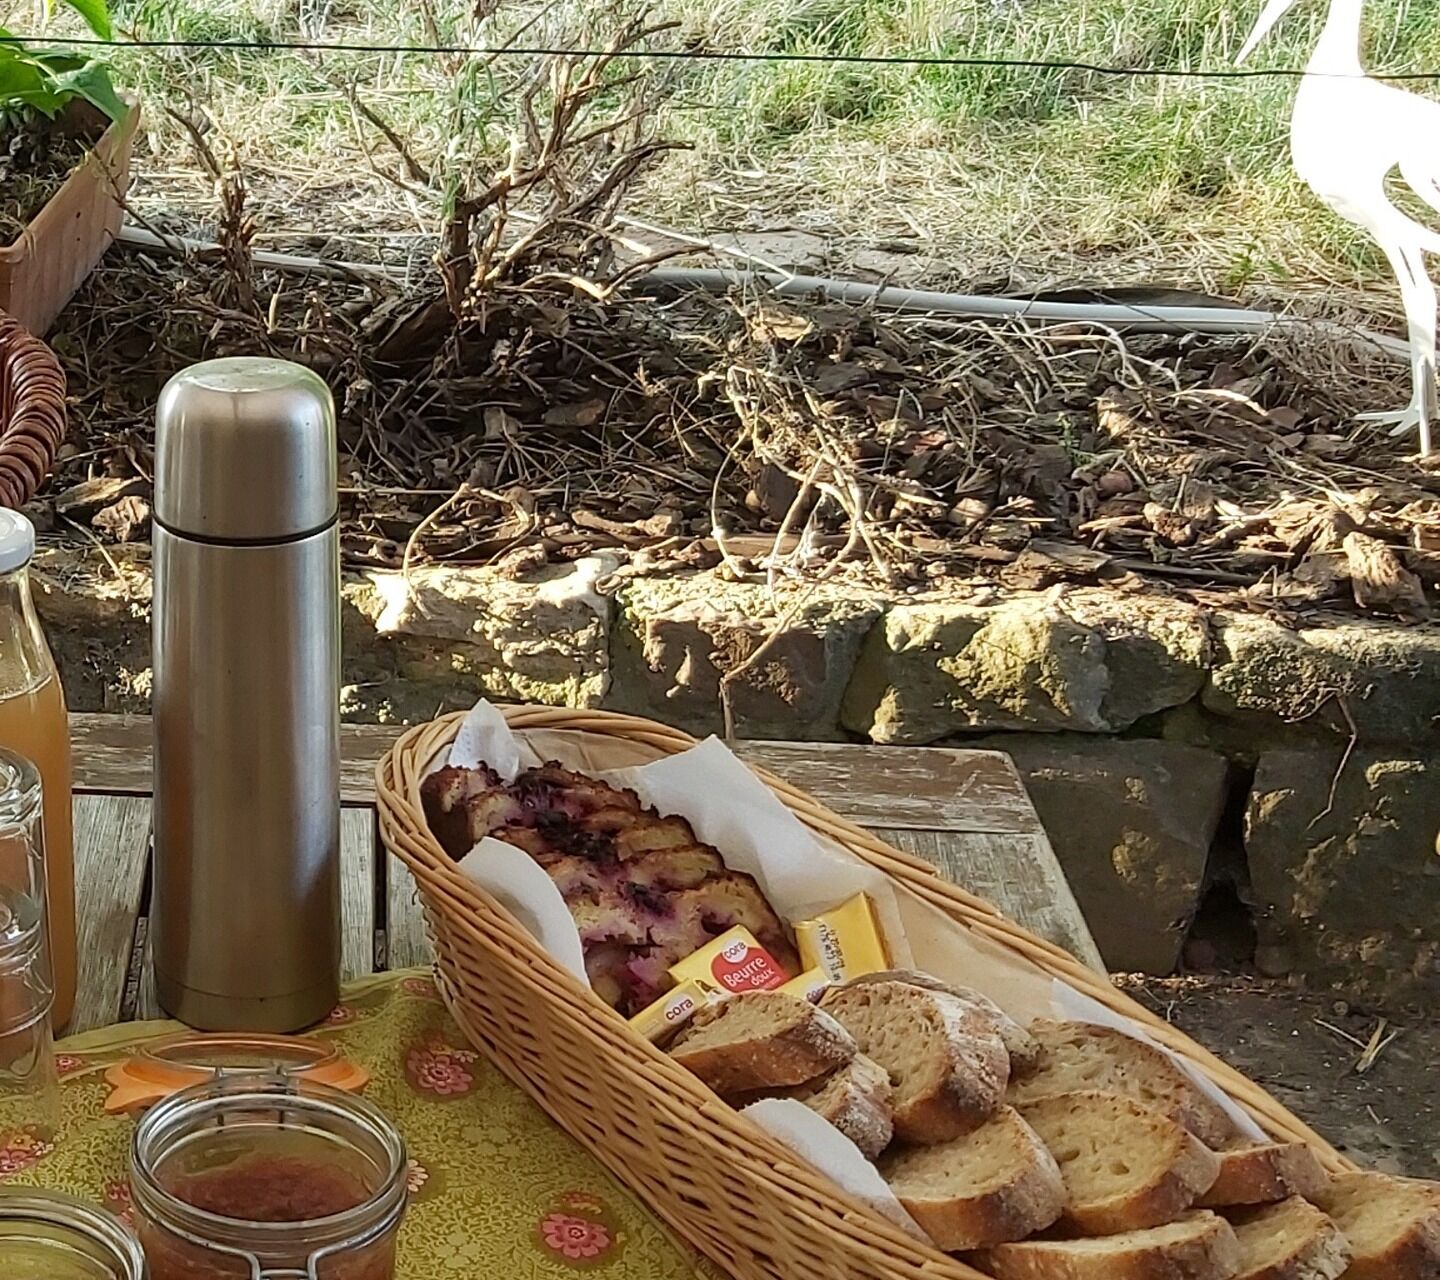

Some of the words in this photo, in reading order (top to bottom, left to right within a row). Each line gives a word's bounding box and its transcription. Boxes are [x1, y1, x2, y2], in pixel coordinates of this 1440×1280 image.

[723, 941, 746, 959] cora
[723, 956, 767, 987] Beurre
[750, 968, 775, 986] doux
[665, 997, 694, 1021] cora
